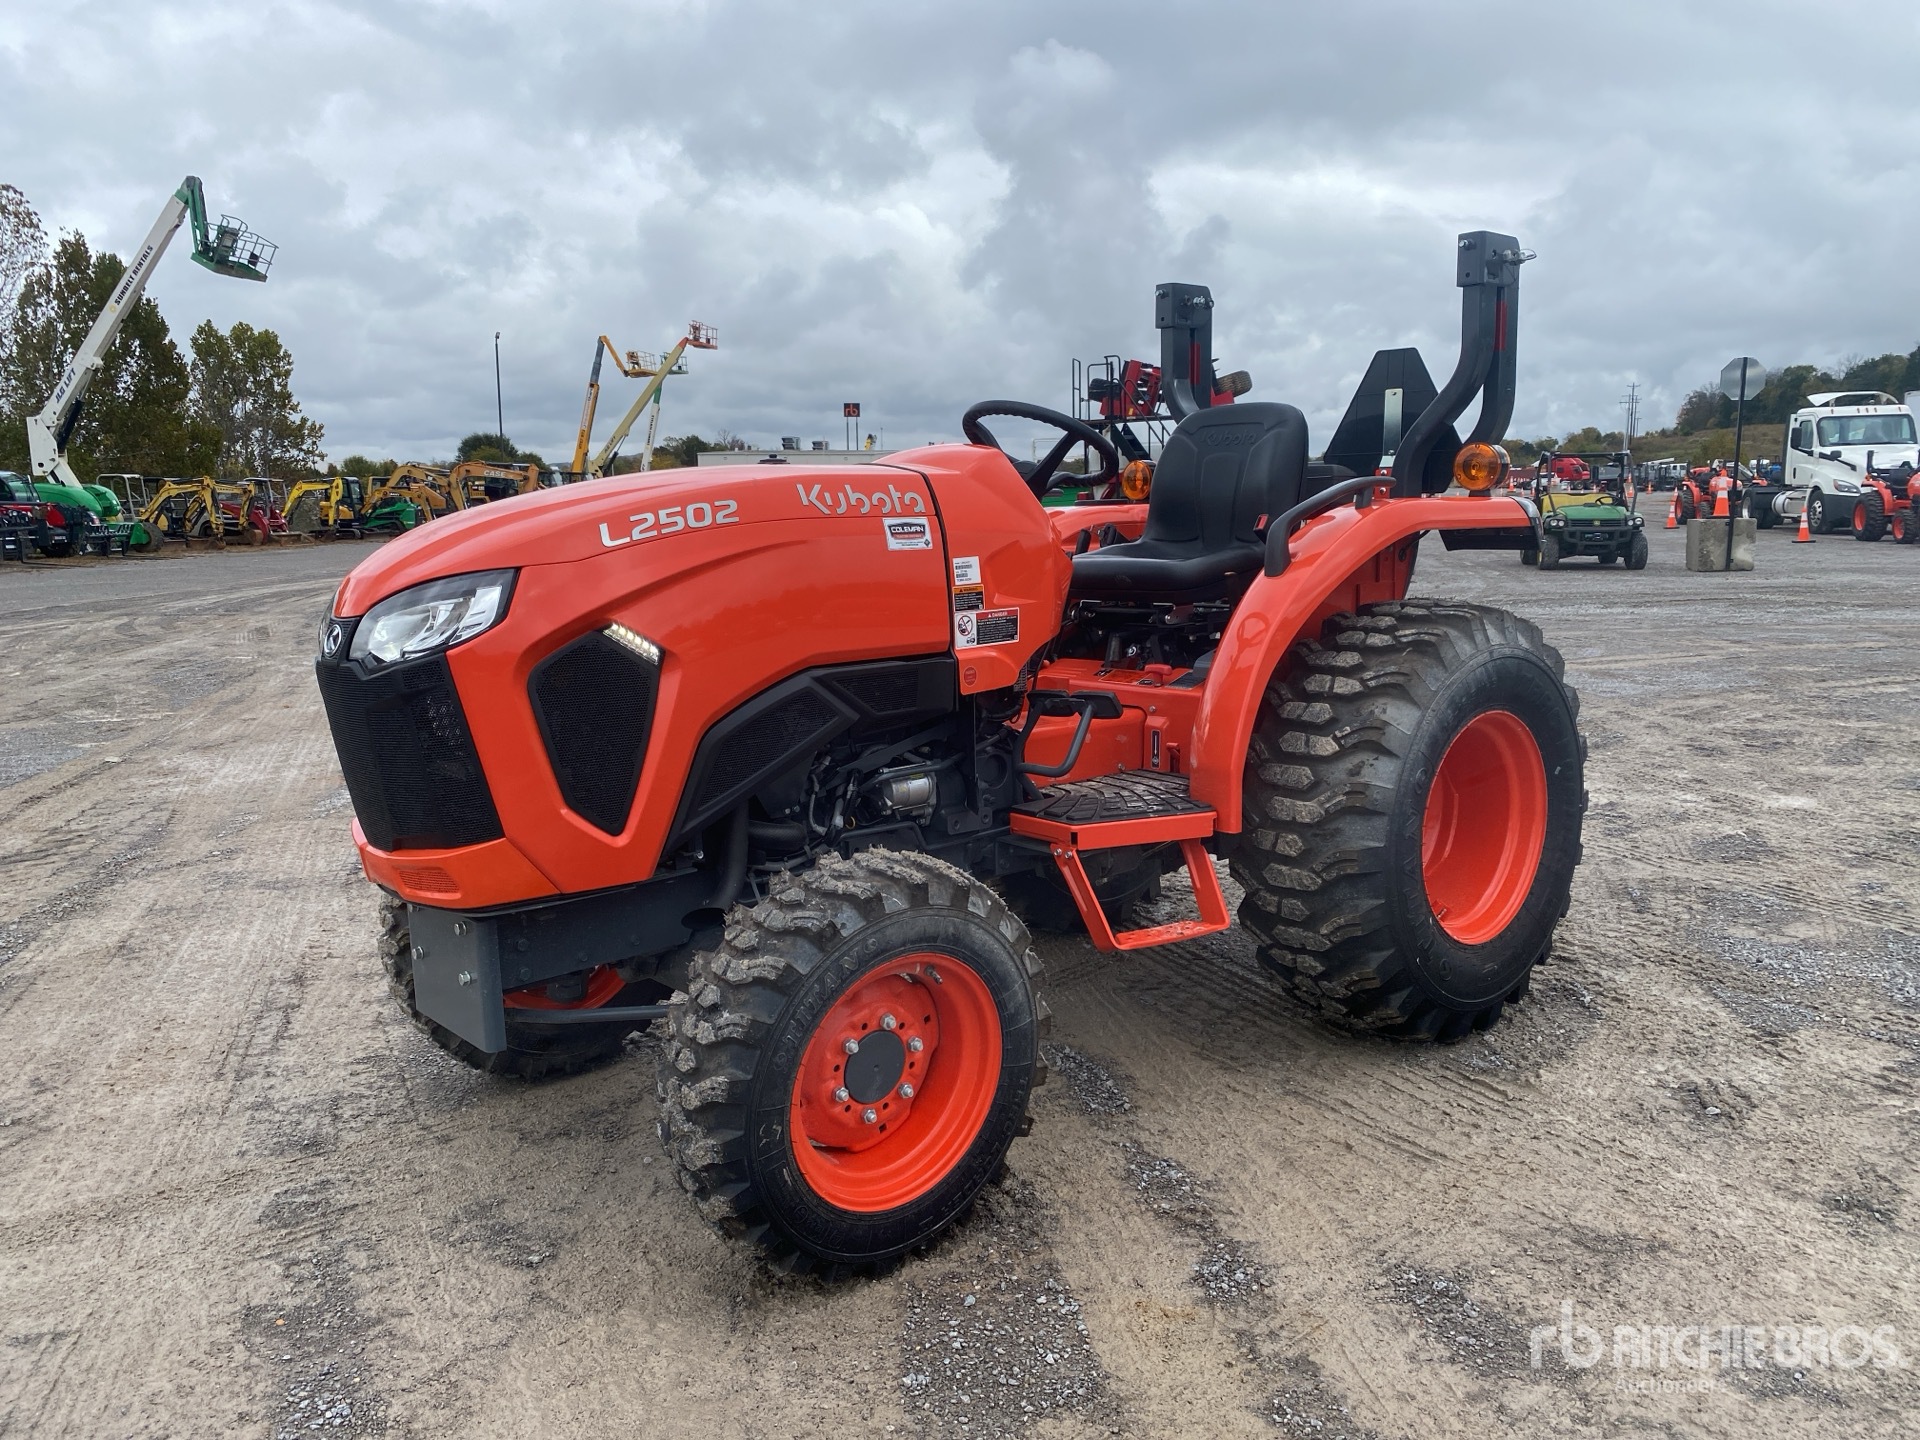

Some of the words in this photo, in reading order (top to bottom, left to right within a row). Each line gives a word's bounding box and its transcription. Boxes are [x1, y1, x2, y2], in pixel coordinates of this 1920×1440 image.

[114, 274, 135, 306] SUNBELT
[132, 245, 153, 276] RENTALS
[55, 386, 66, 404] JLG
[64, 367, 76, 388] LIFT
[845, 403, 858, 416] rb
[483, 469, 507, 478] CASE
[796, 483, 926, 515] Kubota
[599, 499, 740, 548] L2502
[782, 946, 859, 1047] TITAN
